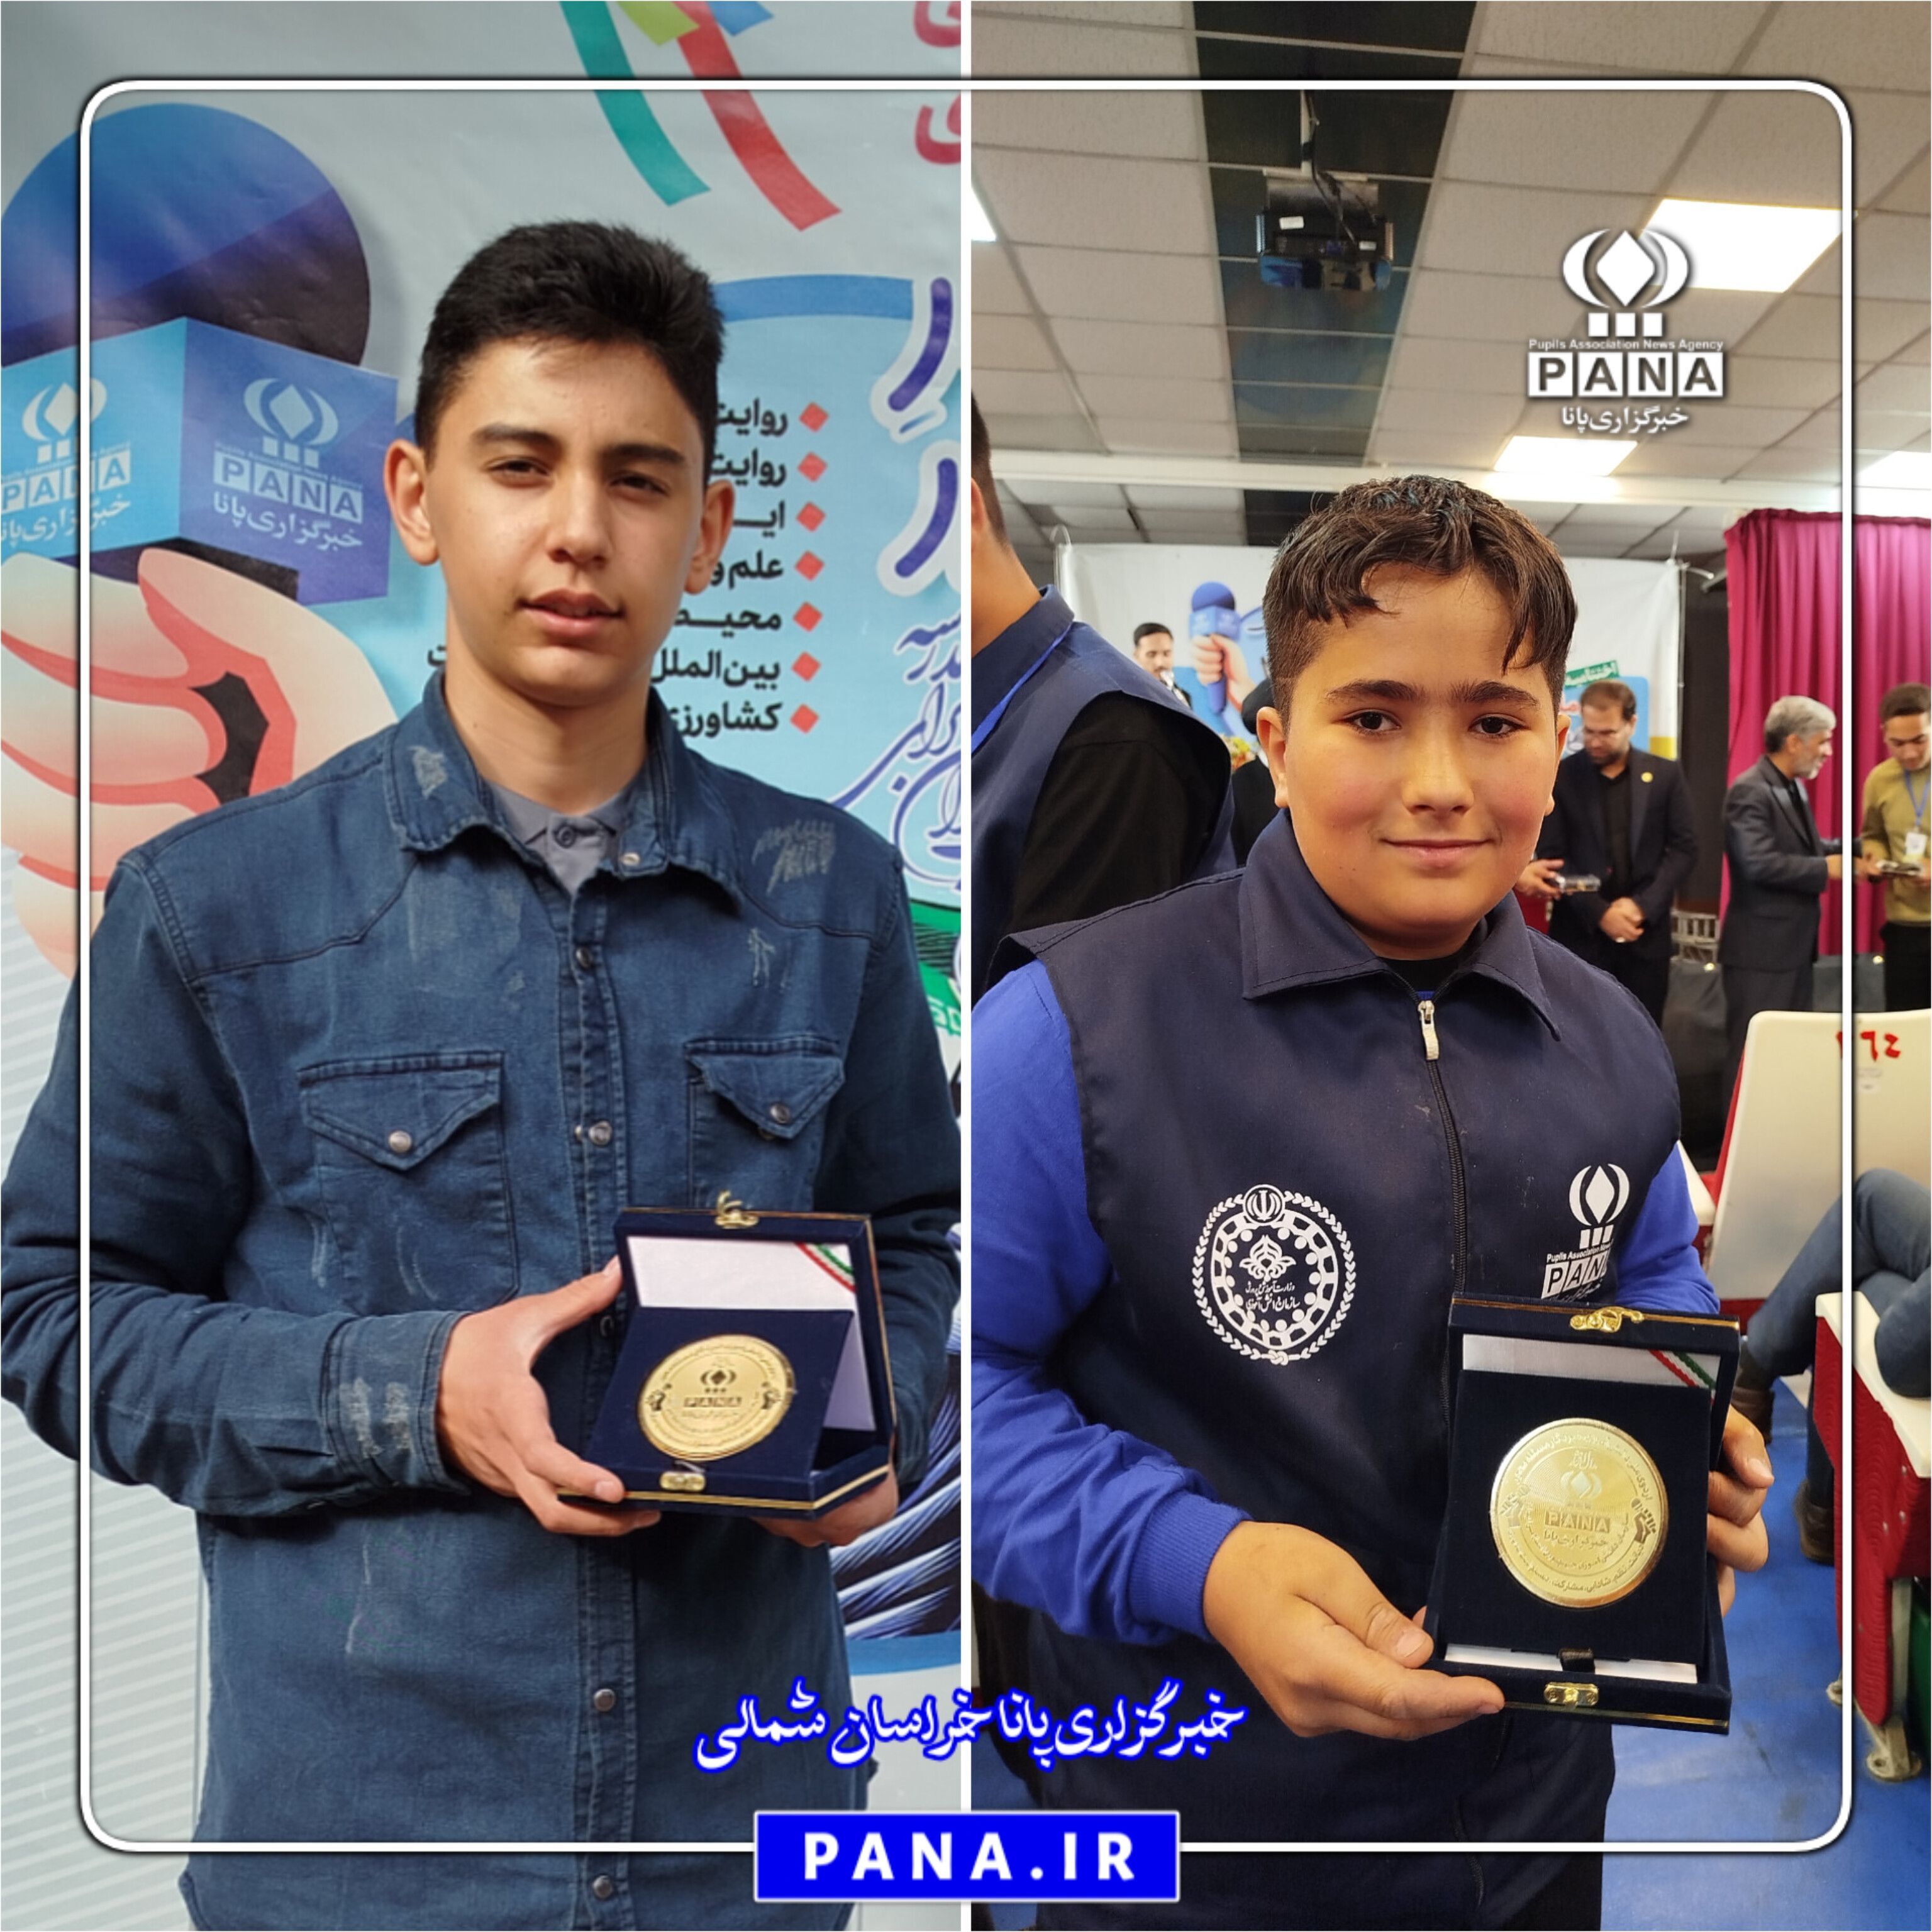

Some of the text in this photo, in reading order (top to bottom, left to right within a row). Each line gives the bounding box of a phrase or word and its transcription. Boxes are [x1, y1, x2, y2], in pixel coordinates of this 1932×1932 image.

[1, 449, 131, 514] PAA
[214, 450, 363, 524] PANA
[214, 491, 363, 551] خبرگزاری پانا
[728, 549, 784, 590] علم
[1541, 1250, 1610, 1300] PAN
[1546, 1252, 1567, 1264] Pupils
[1545, 1510, 1611, 1534] PANA
